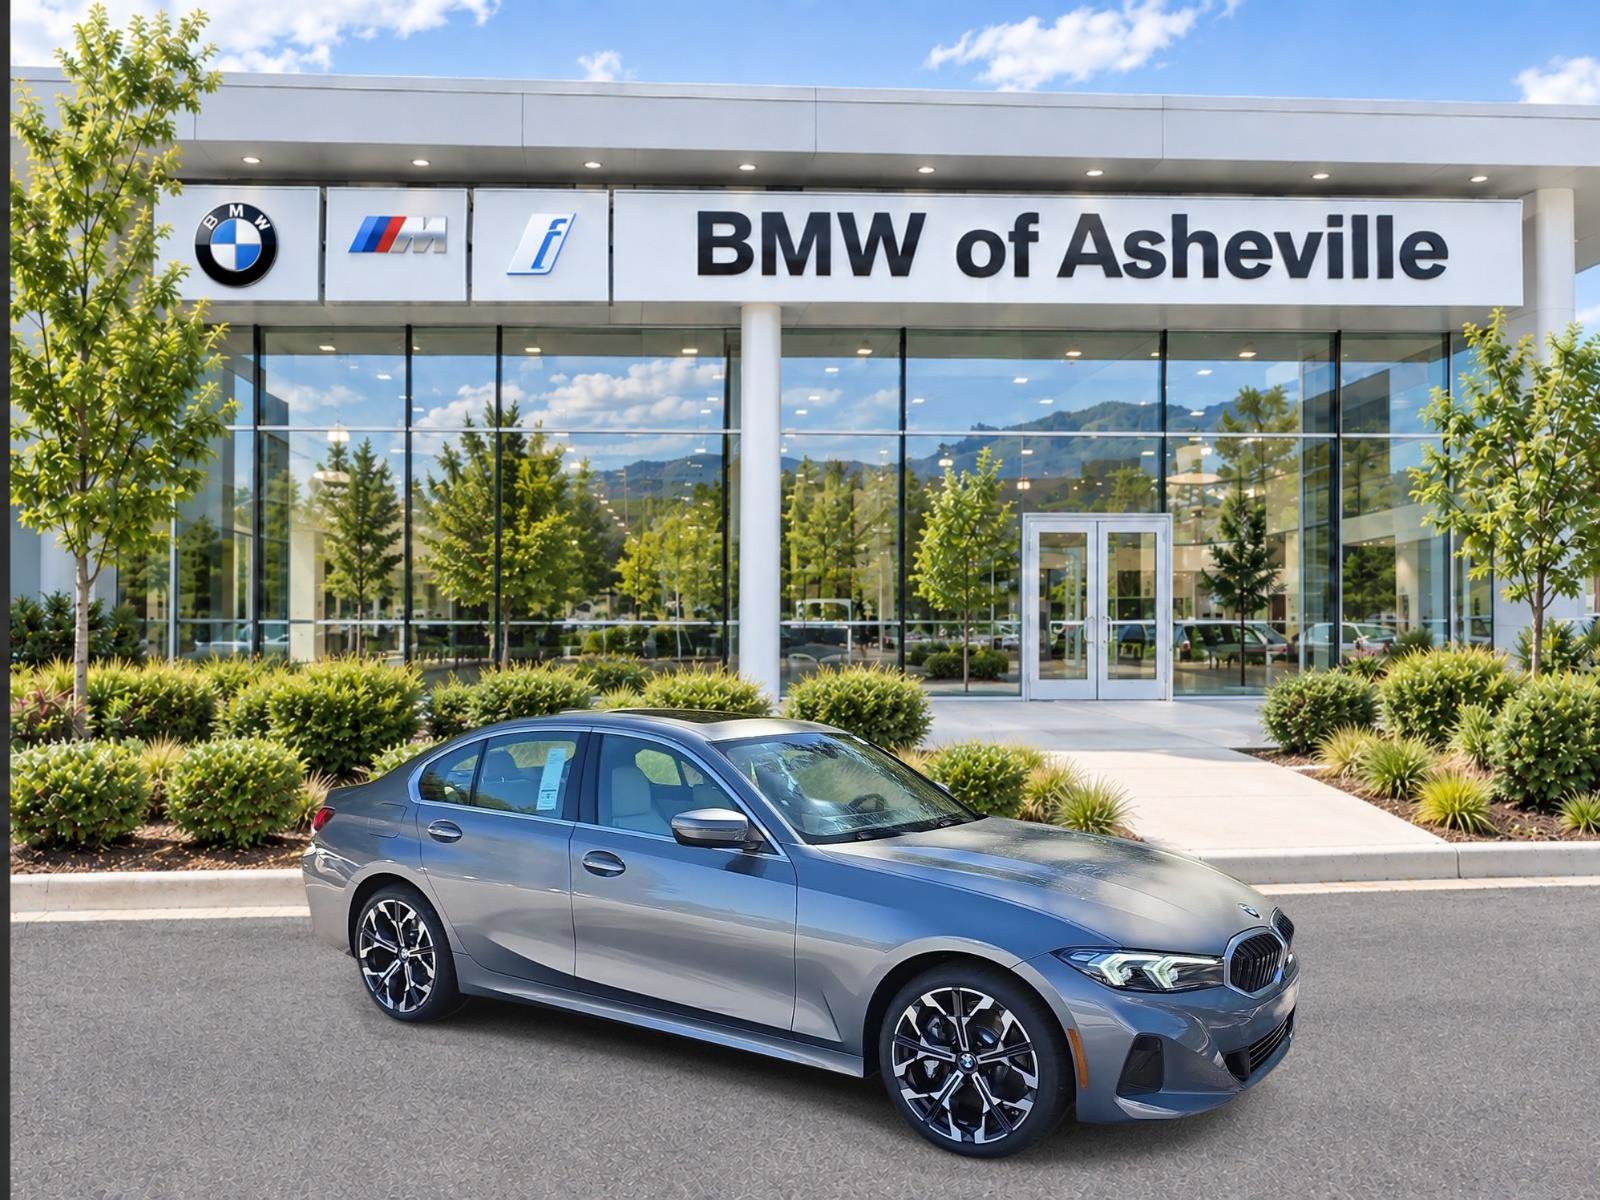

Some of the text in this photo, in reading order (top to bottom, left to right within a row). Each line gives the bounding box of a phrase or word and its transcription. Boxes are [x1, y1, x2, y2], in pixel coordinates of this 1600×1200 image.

[203, 204, 271, 231] BMW
[389, 216, 448, 254] M
[697, 210, 1449, 281] BMW of Asheville
